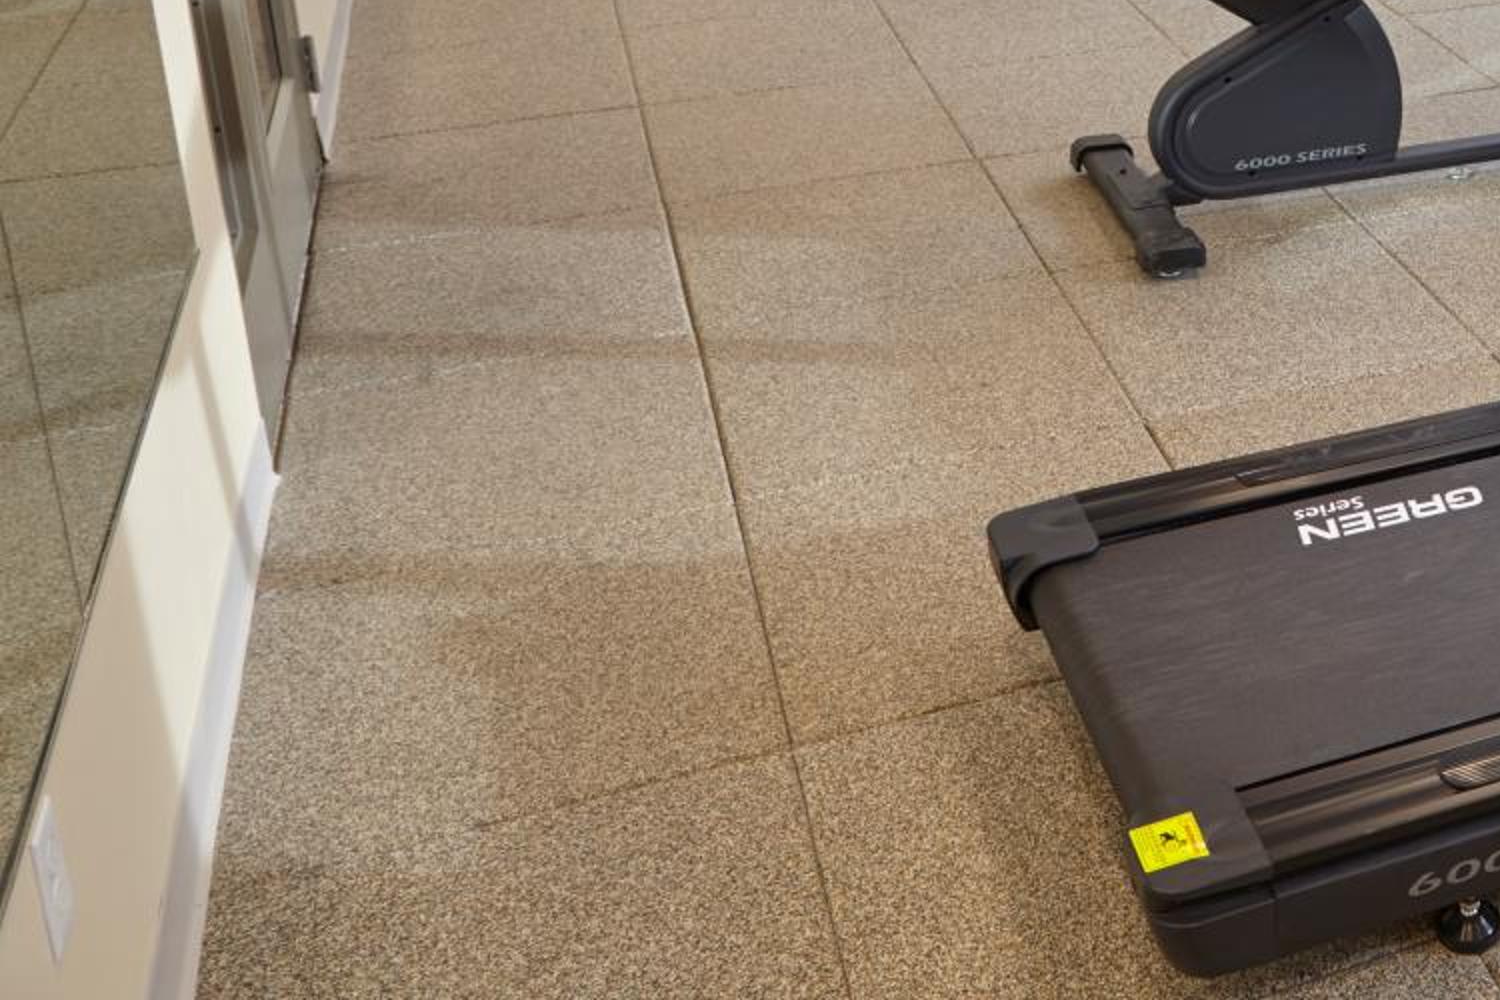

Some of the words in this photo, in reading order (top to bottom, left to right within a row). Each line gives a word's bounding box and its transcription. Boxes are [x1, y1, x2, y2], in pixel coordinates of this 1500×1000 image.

[1234, 154, 1291, 171] 6000
[1296, 143, 1367, 163] SERIES
[1293, 495, 1364, 521] Series
[1297, 485, 1483, 545] GREEN
